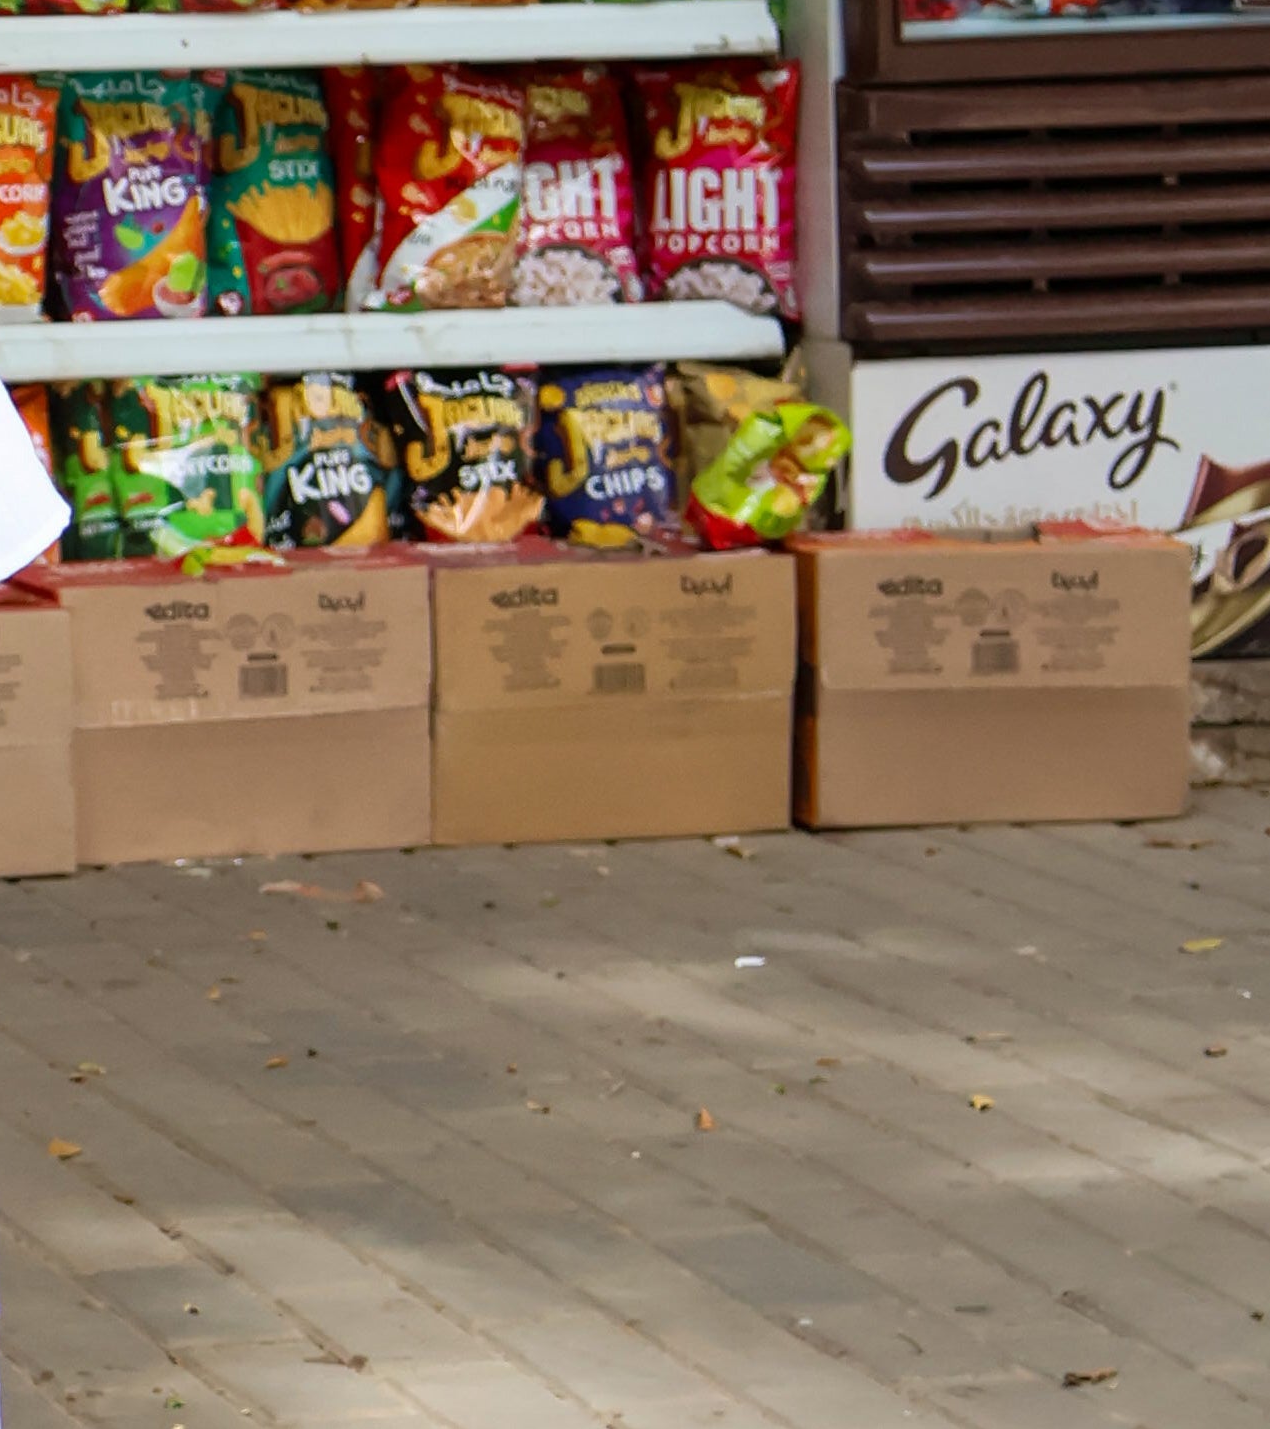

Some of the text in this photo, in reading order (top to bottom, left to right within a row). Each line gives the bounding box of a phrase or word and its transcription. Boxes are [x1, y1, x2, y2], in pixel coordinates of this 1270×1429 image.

[102, 176, 188, 217] KING
[652, 165, 783, 233] LIGHT
[882, 369, 1182, 502] Galaxy
[288, 461, 375, 504] KING
[584, 471, 667, 502] CHIPS
